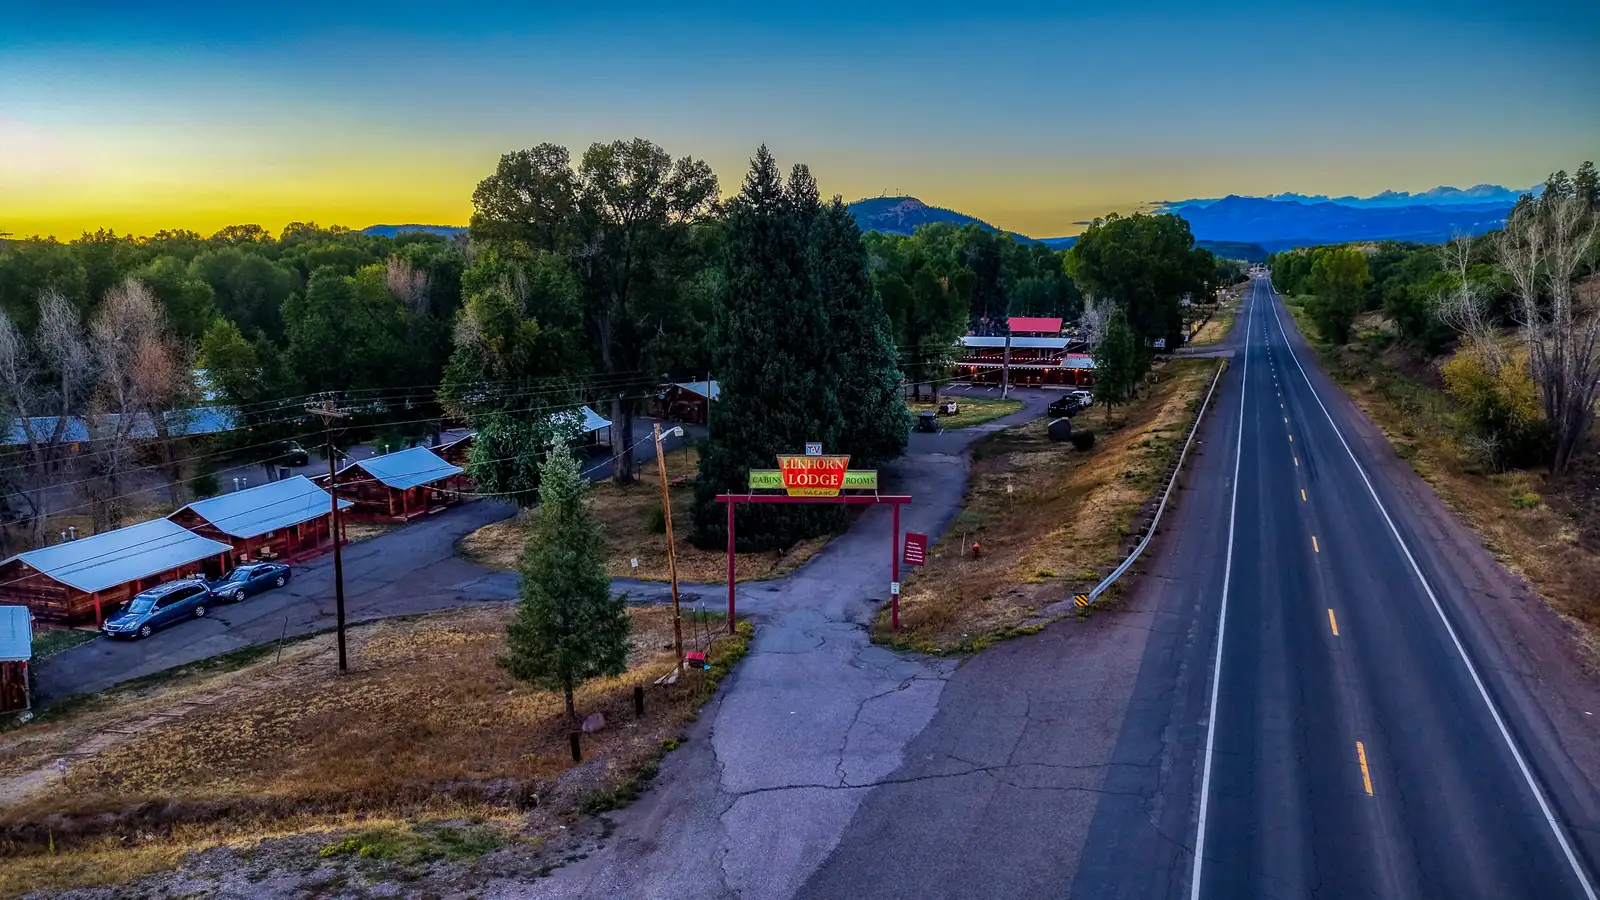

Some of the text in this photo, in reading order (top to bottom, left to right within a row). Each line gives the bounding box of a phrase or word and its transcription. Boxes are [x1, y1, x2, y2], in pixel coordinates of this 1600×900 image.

[783, 459, 845, 469] ELKHORN
[752, 476, 782, 484] CABINS
[788, 473, 839, 485] LODGE
[845, 477, 875, 485] ROOMS
